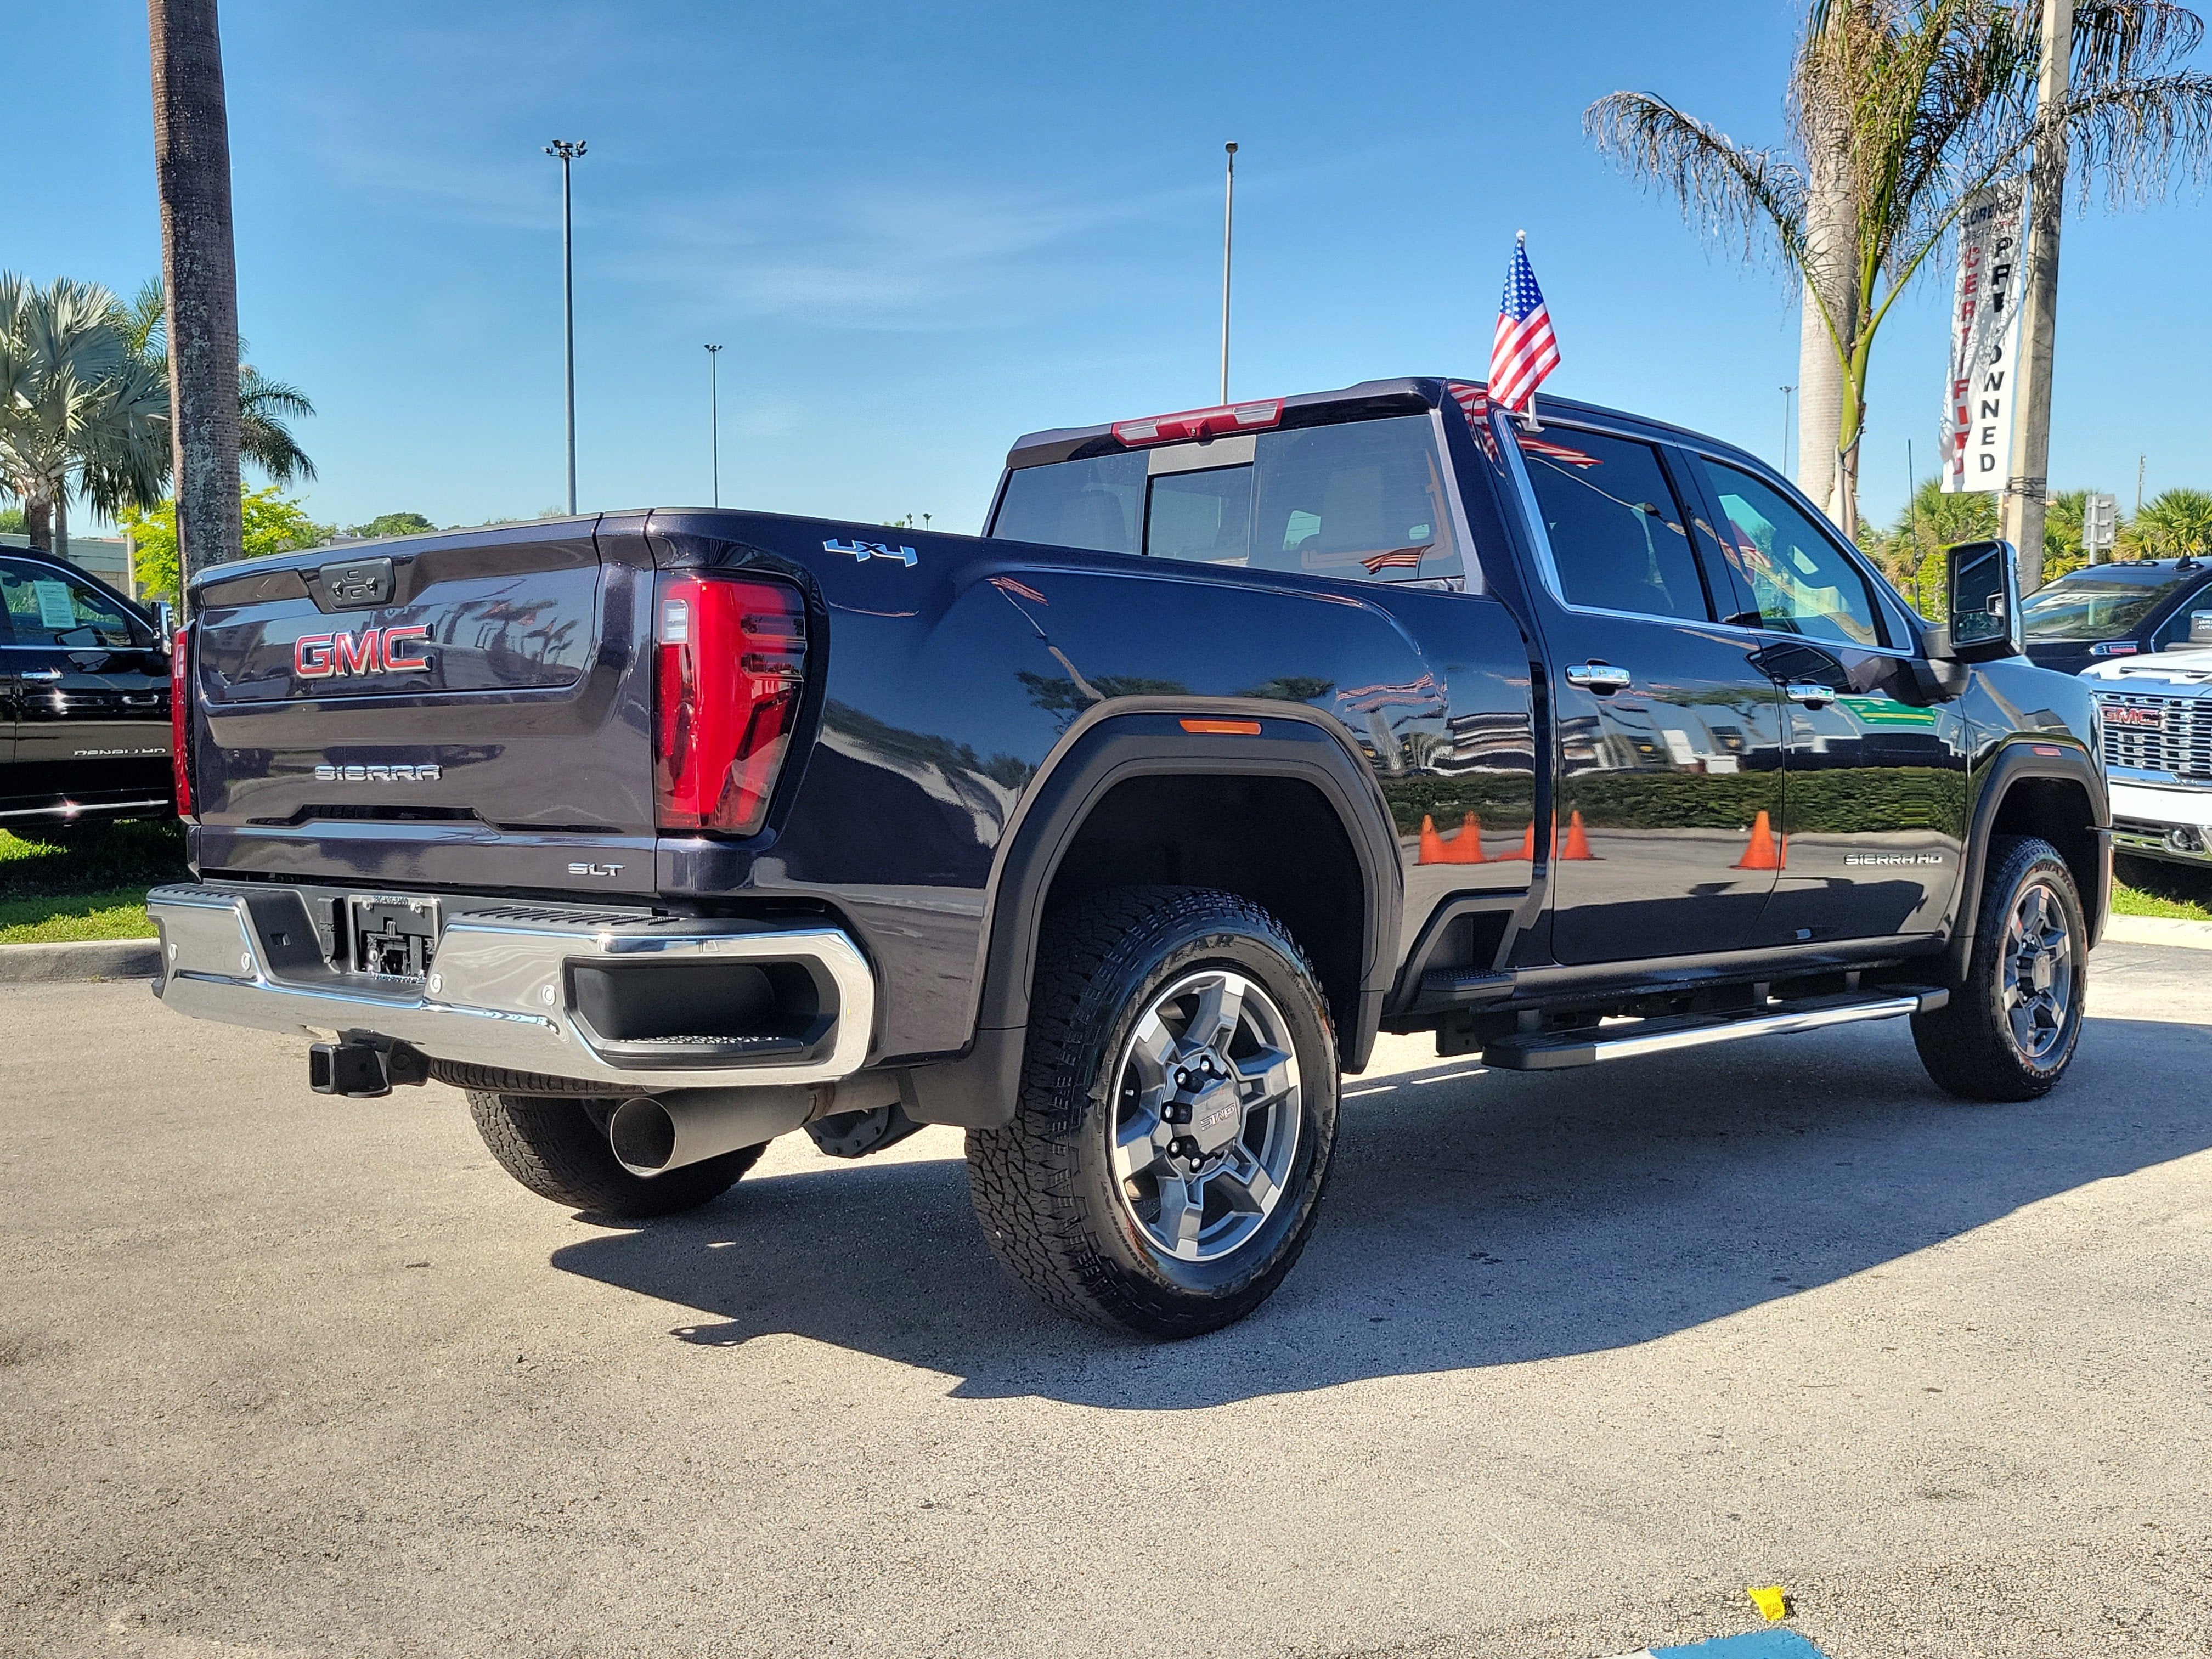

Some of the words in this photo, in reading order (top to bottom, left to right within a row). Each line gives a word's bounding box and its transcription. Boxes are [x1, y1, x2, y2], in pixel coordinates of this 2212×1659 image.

[295, 623, 435, 679] GMC
[2101, 706, 2161, 727] GMC
[314, 764, 442, 782] SIERRA
[1844, 854, 1915, 865] SIERRA
[1916, 853, 1943, 864] HD
[568, 862, 626, 877] SLT
[1200, 1102, 1235, 1131] GMC
